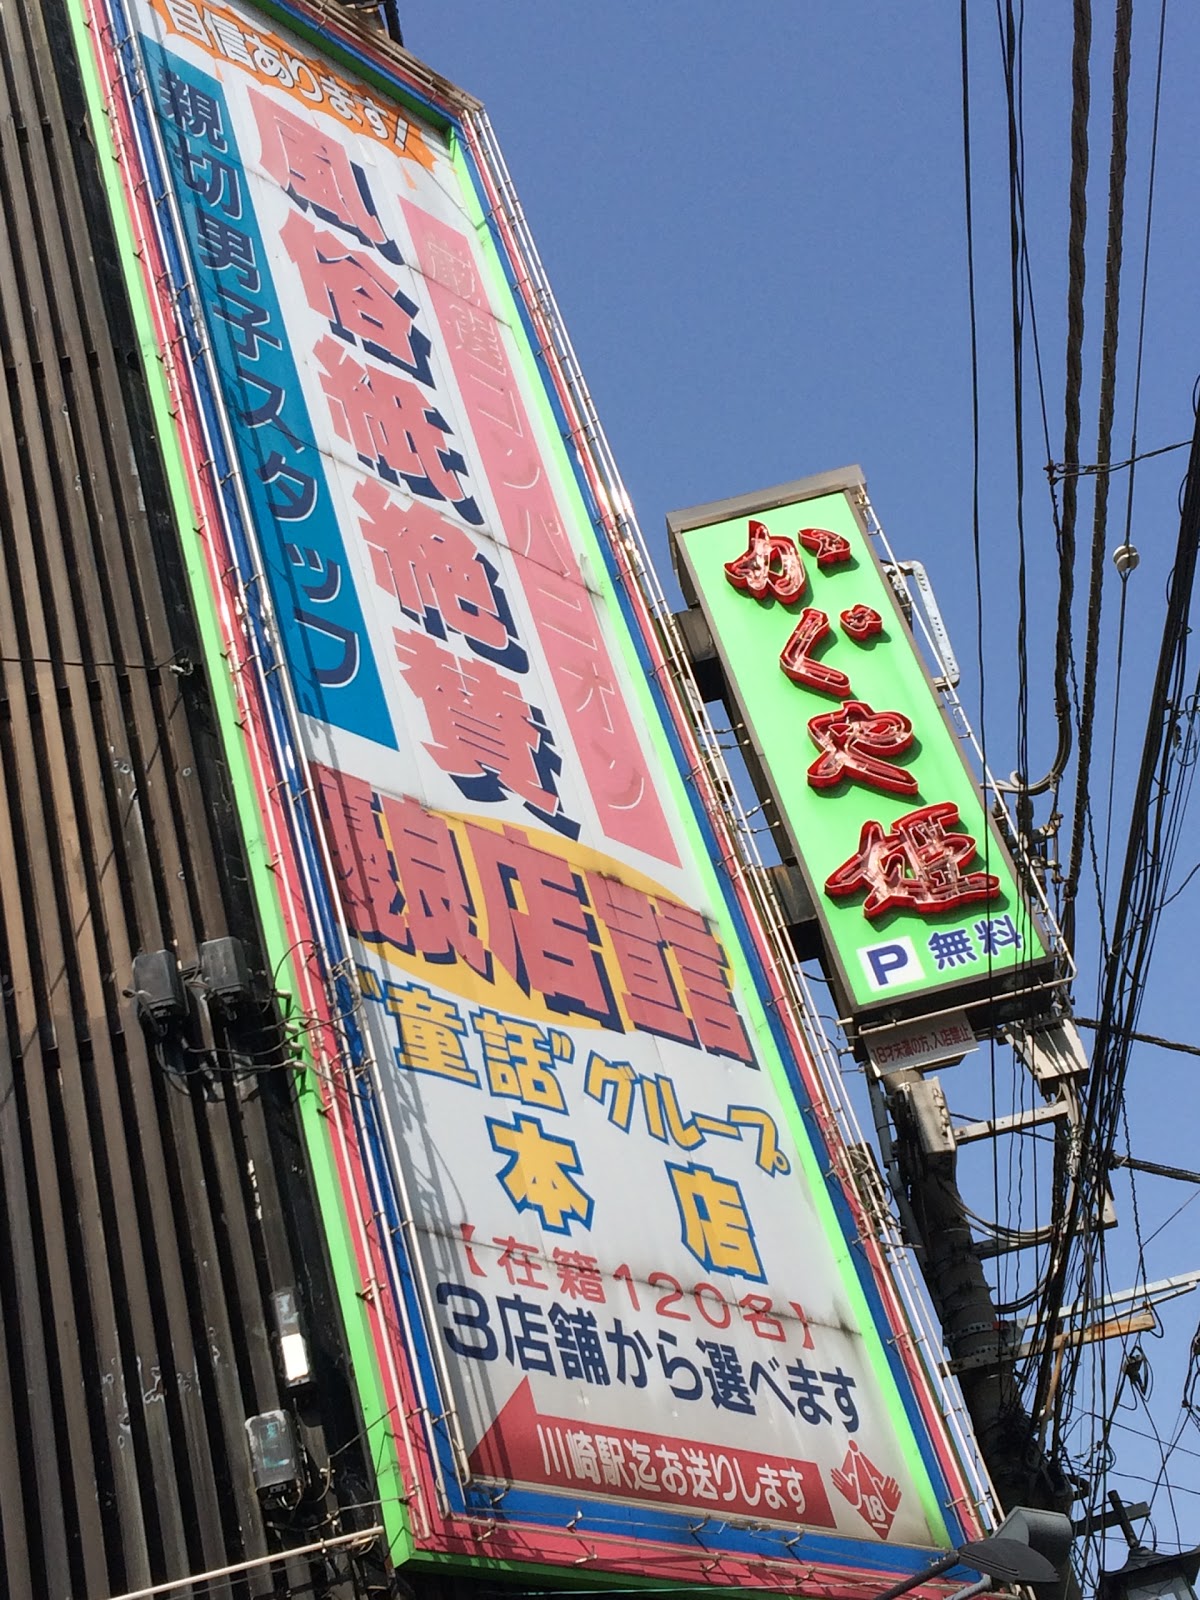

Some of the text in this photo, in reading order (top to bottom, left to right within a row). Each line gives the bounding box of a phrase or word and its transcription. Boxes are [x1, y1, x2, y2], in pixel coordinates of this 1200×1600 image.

[157, 66, 361, 688] 親切男子スタッフ
[724, 520, 1001, 918] かぐや姫
[866, 914, 1022, 986] P 無料
[436, 1281, 859, 1433] 3店舗から選べます
[535, 1423, 806, 1515] 川崎駅迄お送りします
[862, 1494, 886, 1522] 18
